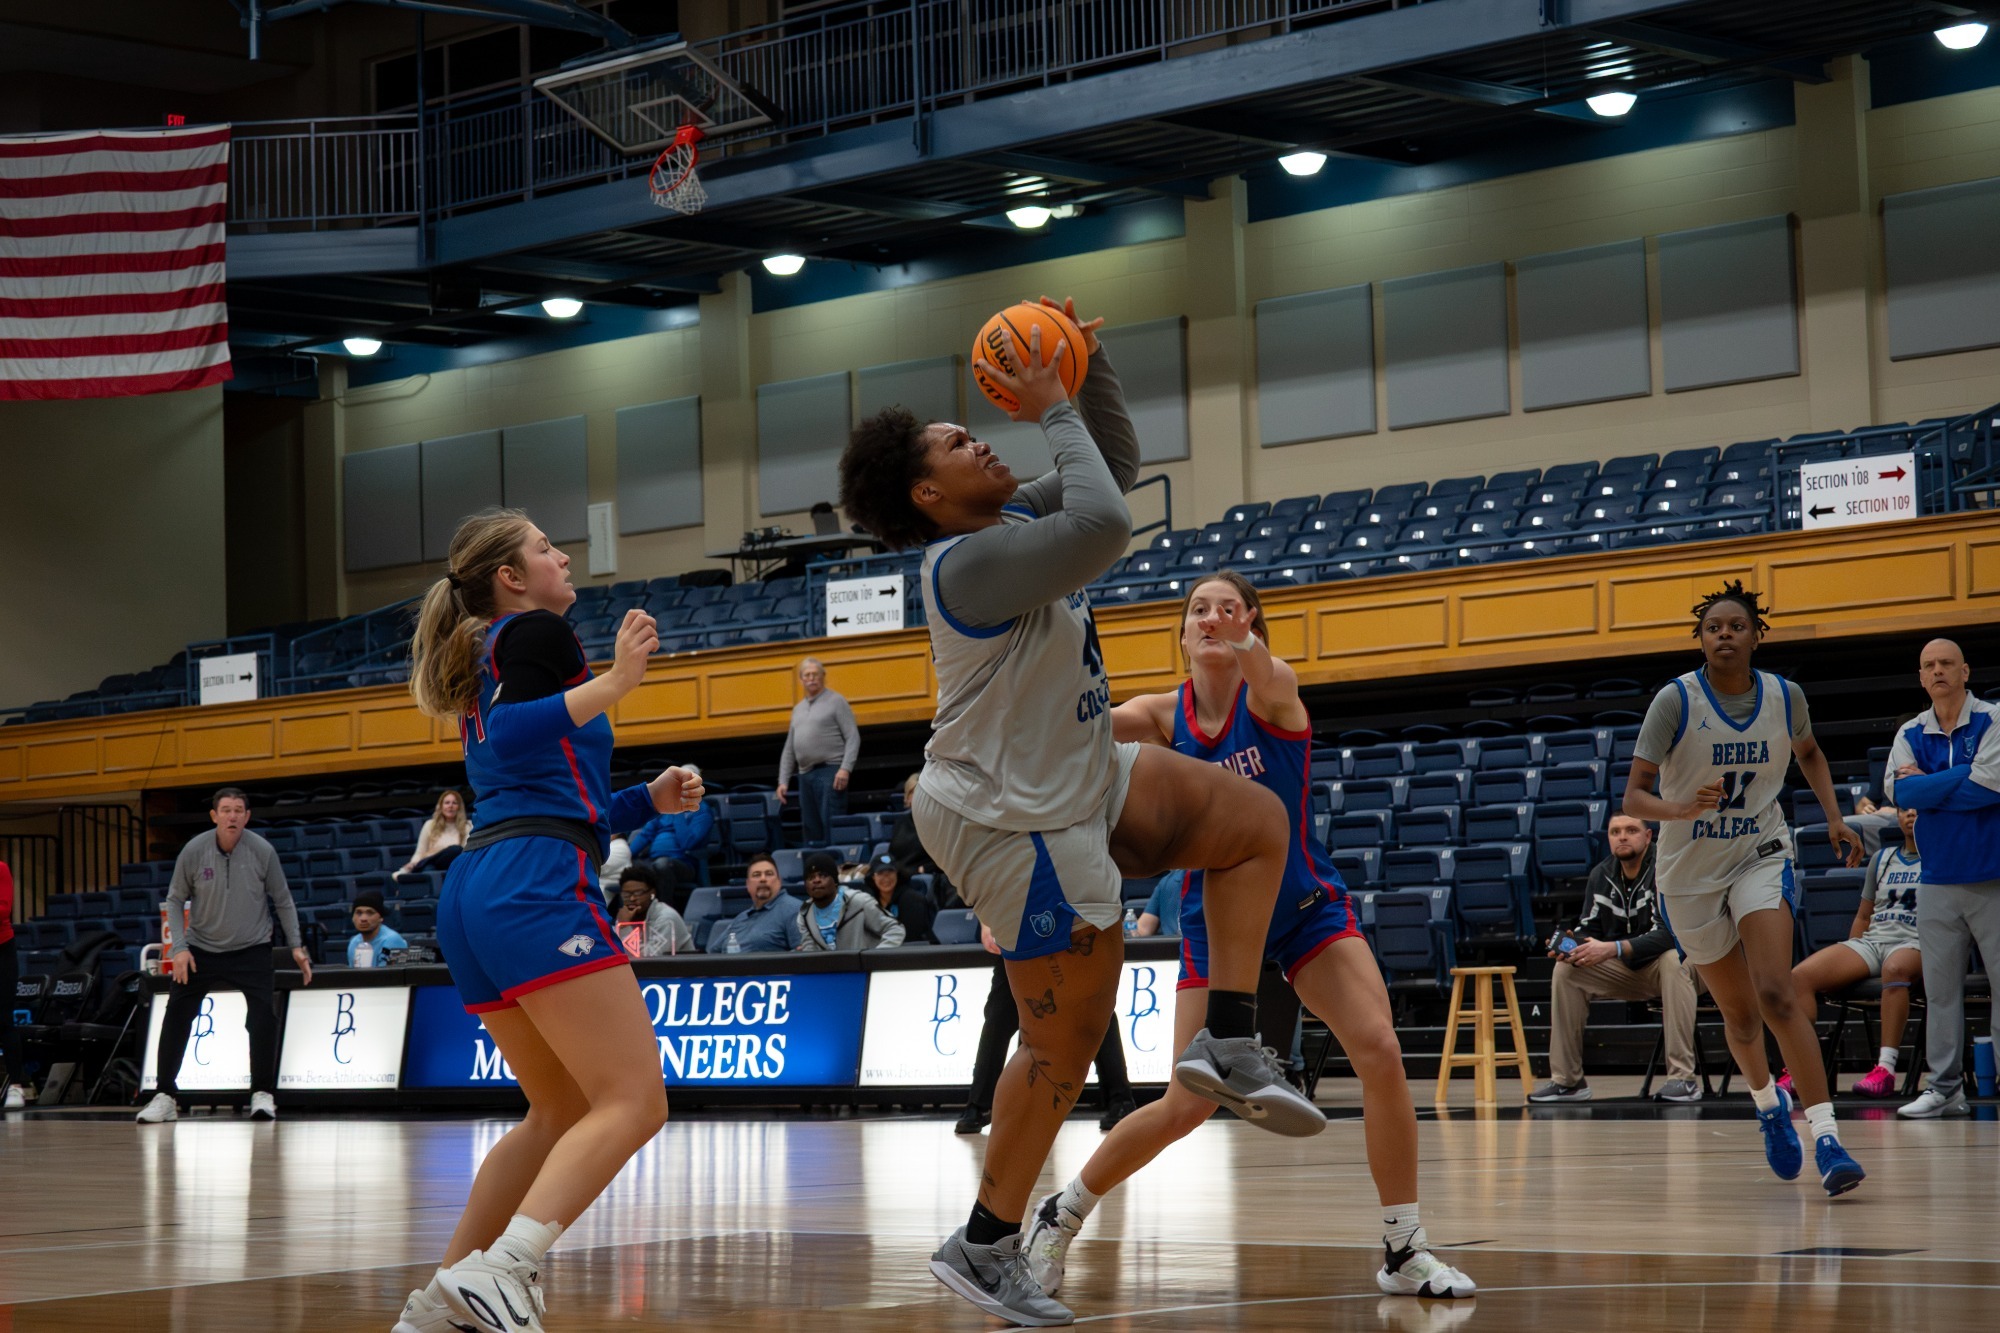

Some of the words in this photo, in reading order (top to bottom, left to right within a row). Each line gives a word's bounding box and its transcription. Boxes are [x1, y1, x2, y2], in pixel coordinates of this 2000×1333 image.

[1805, 472, 1848, 492] SECTION
[1851, 470, 1870, 487] 108
[1846, 497, 1889, 516] SECTION
[1892, 495, 1911, 511] 109
[829, 590, 859, 604] SECTION
[860, 588, 874, 601] 109
[856, 611, 886, 625] SECTION
[887, 609, 900, 622] 110
[202, 675, 225, 689] SECTION
[1711, 740, 1770, 766] BEREA
[1886, 871, 1923, 885] BEREA
[641, 980, 792, 1028] OLLEGE
[1531, 1004, 1541, 1016] A
